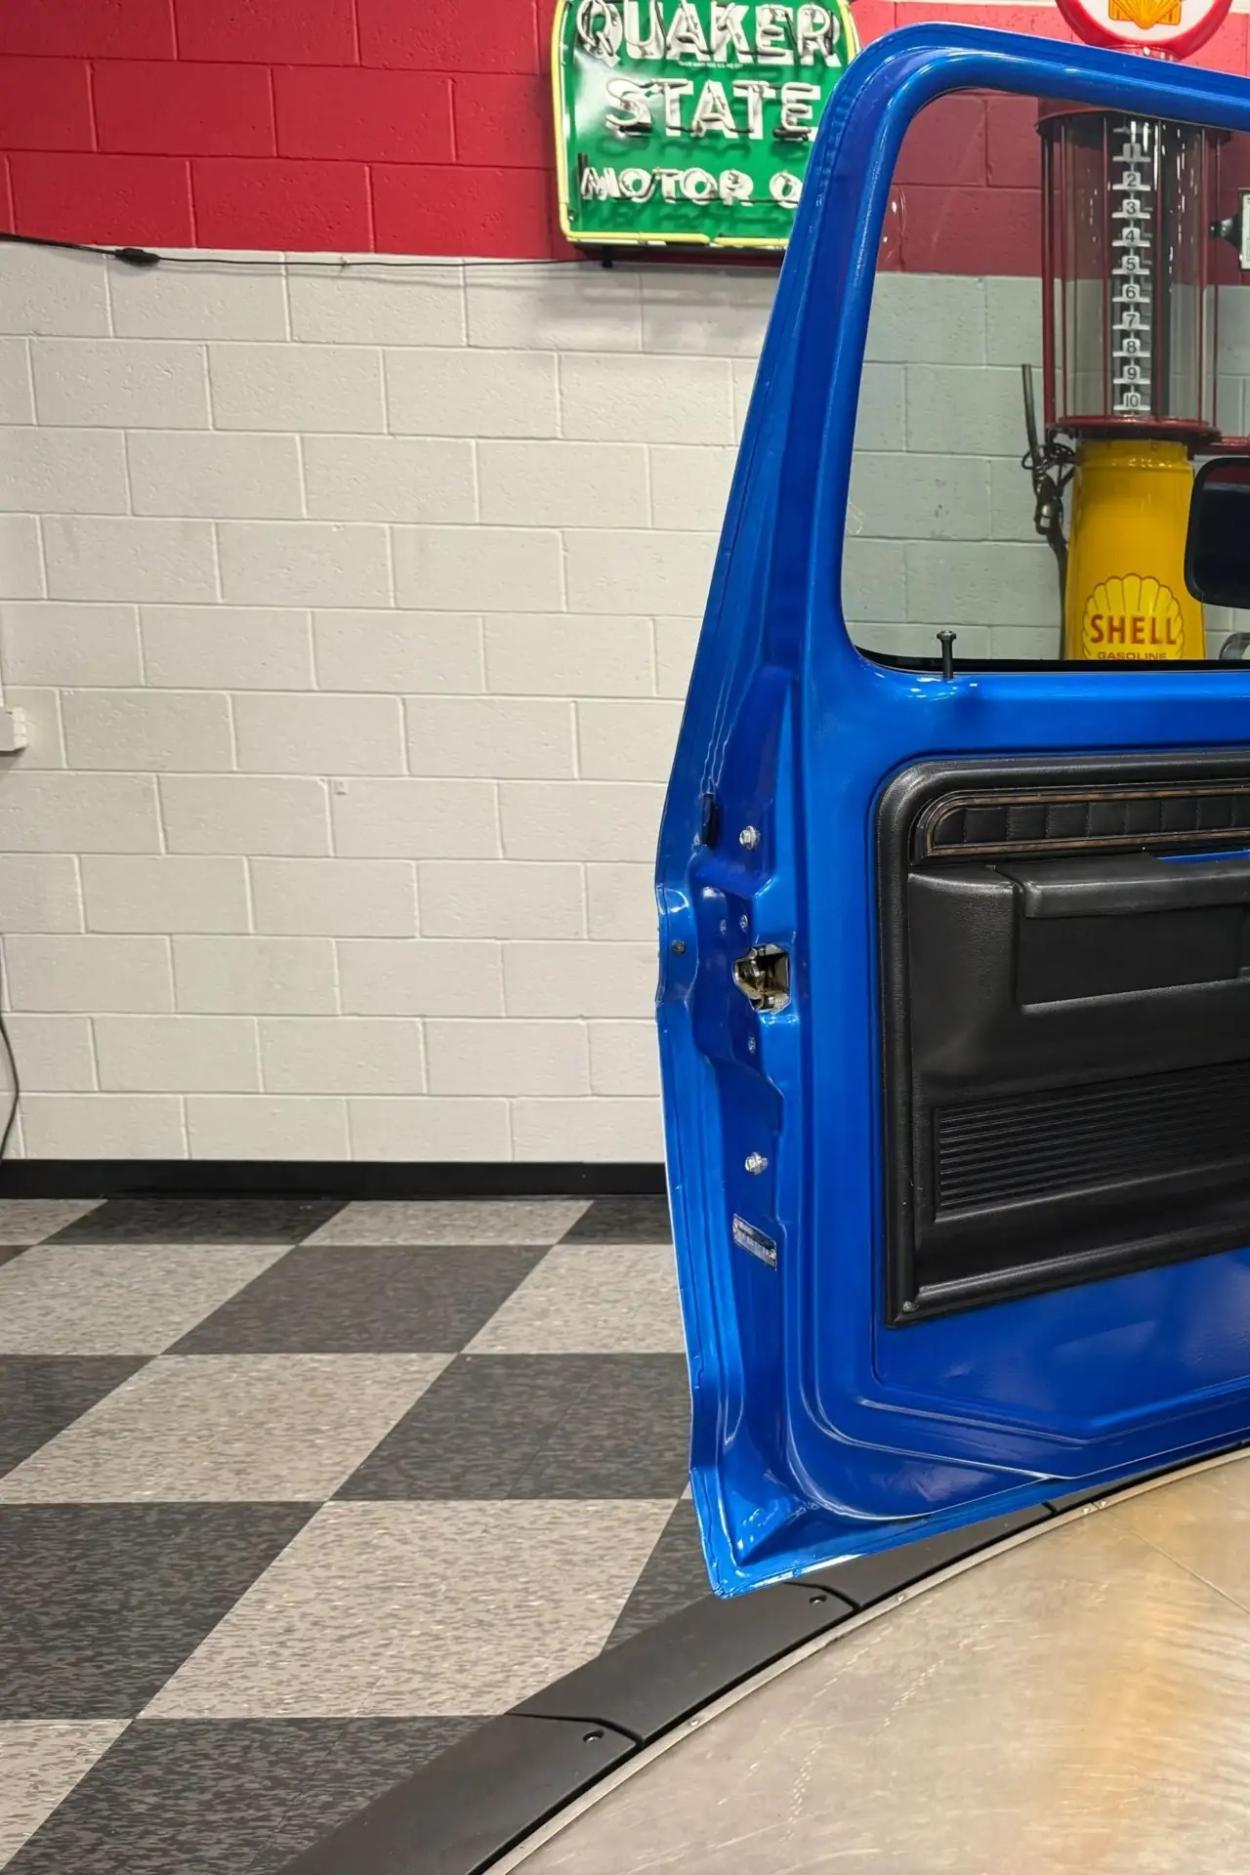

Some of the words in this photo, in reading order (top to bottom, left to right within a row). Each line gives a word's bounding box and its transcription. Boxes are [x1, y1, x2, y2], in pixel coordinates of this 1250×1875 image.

[576, 0, 841, 67] QUAKER
[605, 77, 821, 142] STATE
[580, 167, 754, 207] MOTOR
[1126, 172, 1137, 187] 2
[1125, 200, 1137, 215] 3
[1125, 229, 1136, 243] 4
[1126, 257, 1137, 272] 5
[1125, 285, 1137, 300] 6
[1126, 313, 1137, 328] 7
[1126, 340, 1137, 354] 8
[1126, 366, 1138, 381] 9
[1125, 394, 1139, 408] 10
[1091, 614, 1177, 645] SHELL
